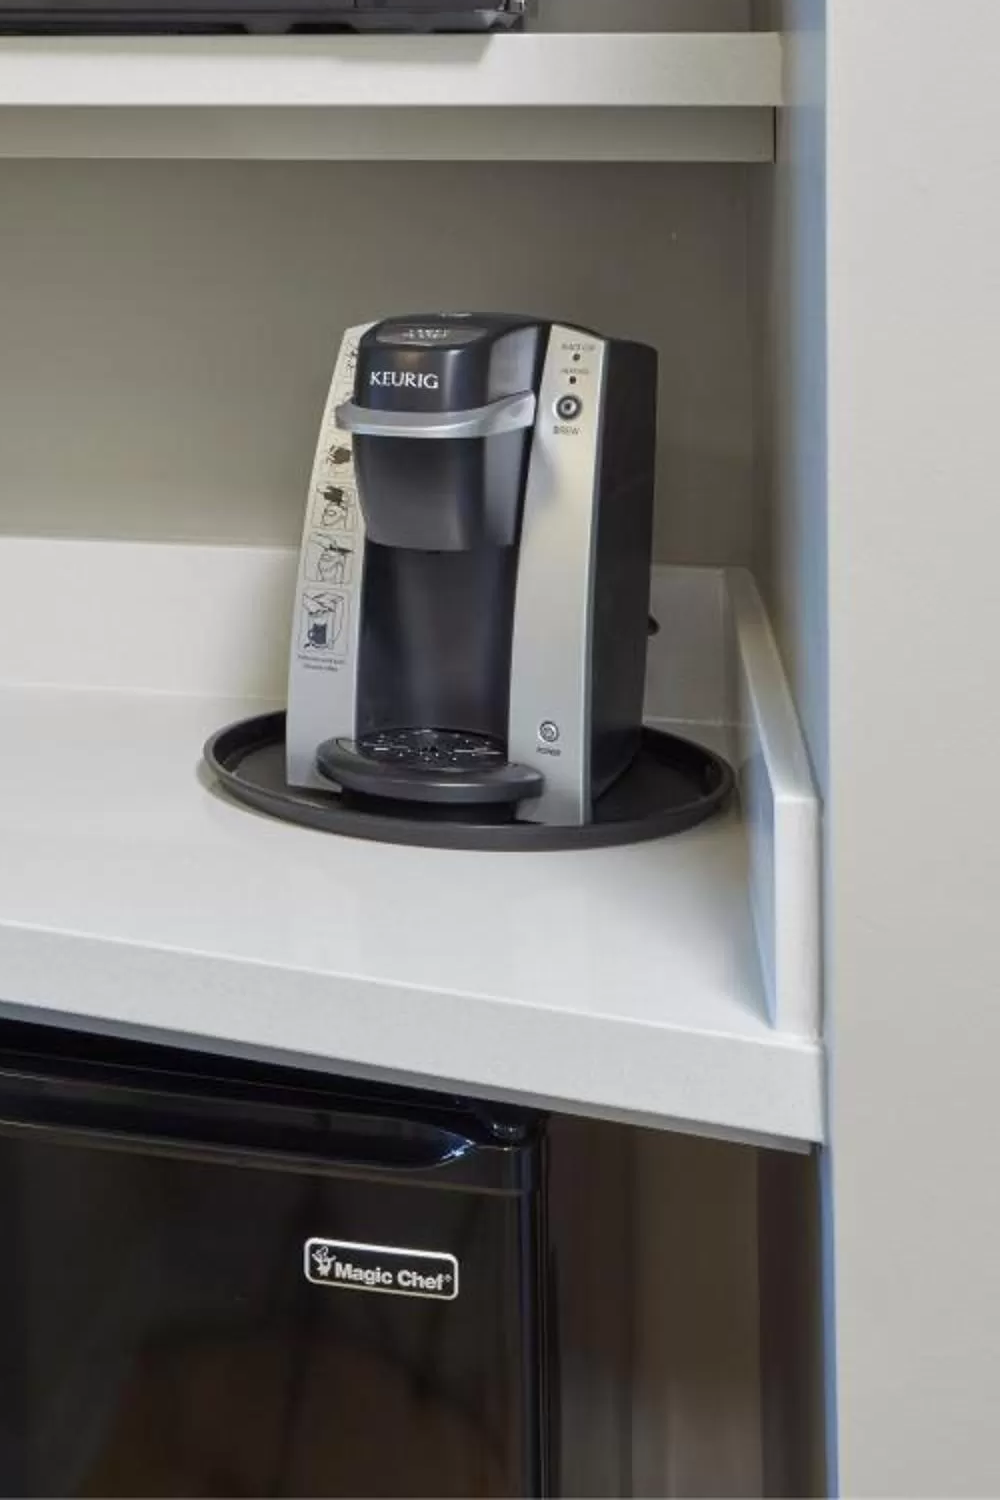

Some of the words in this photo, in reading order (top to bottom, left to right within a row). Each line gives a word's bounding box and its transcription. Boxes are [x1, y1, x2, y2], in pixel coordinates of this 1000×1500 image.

[369, 371, 439, 390] KEURIG
[334, 1261, 393, 1285] Magic
[397, 1269, 445, 1290] Chef
